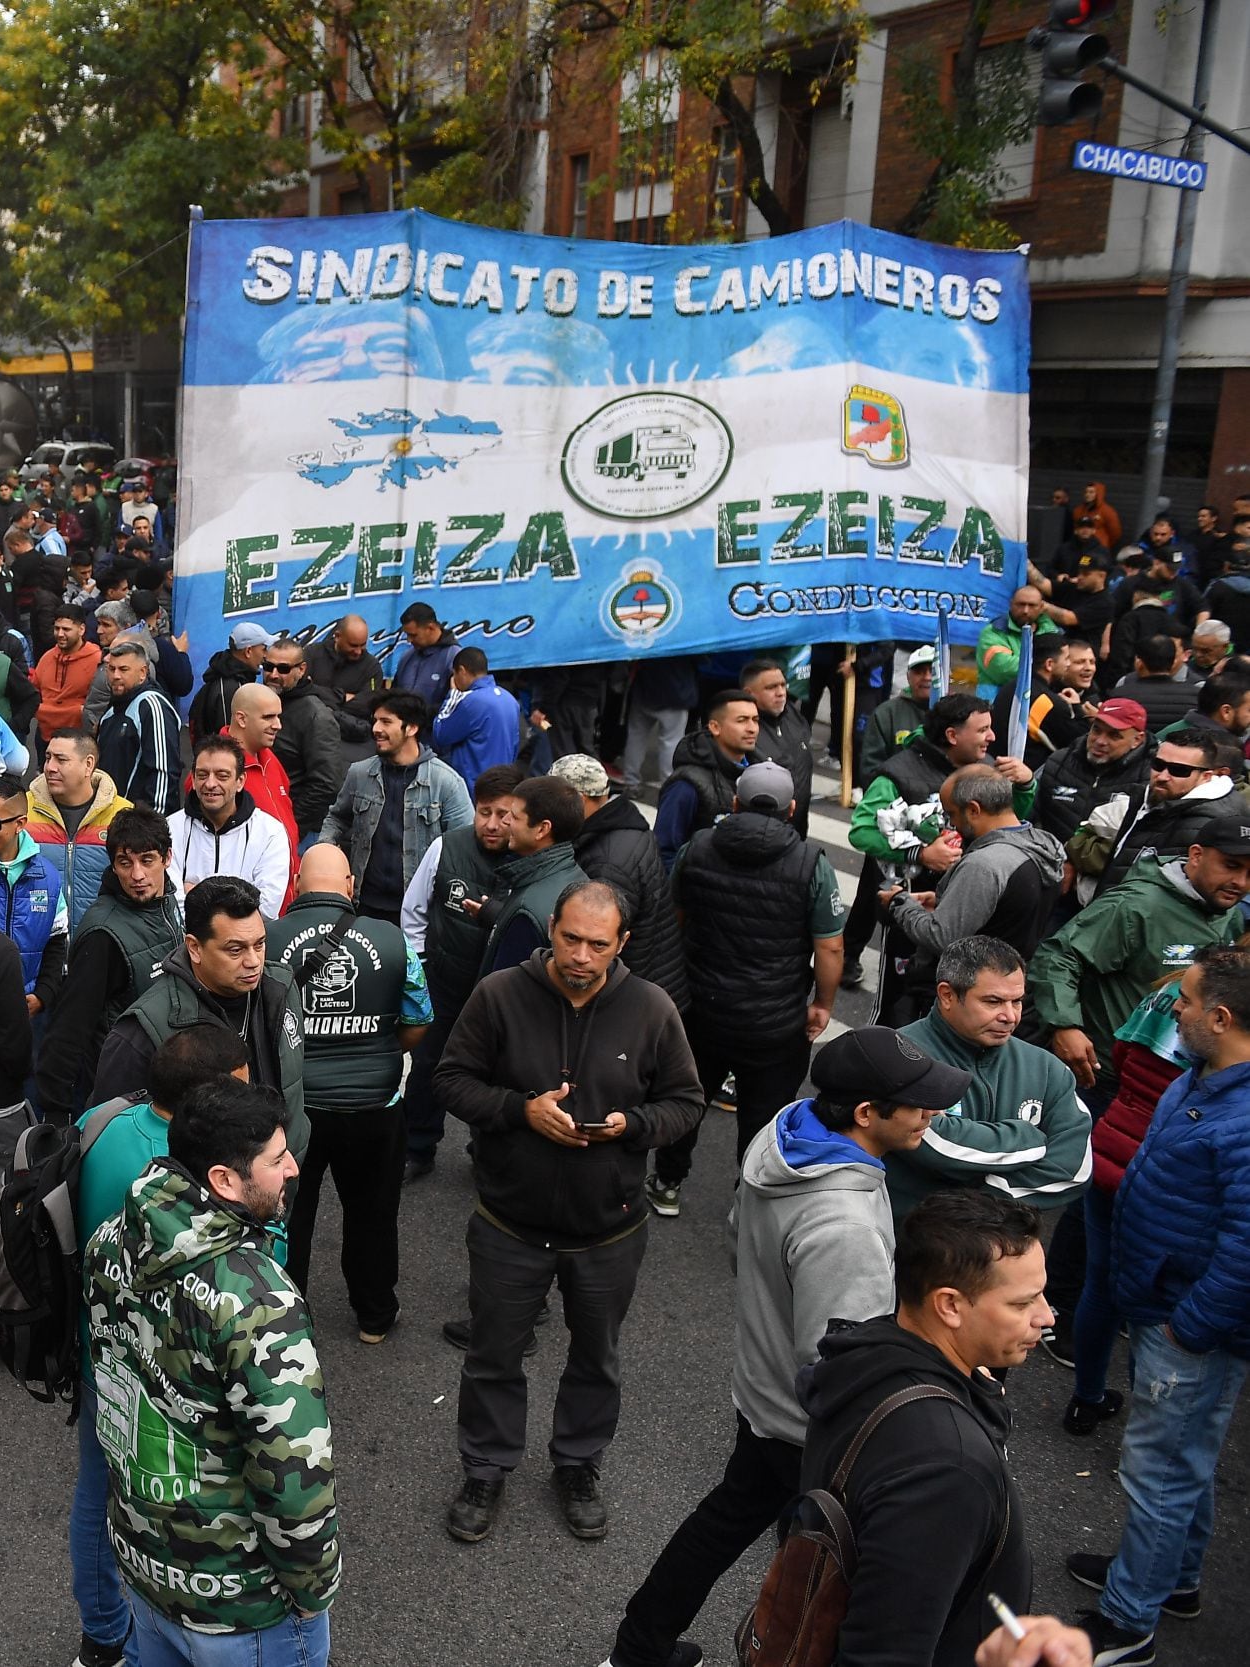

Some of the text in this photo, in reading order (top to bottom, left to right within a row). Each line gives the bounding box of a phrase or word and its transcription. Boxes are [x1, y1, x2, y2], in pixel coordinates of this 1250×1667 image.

[1078, 144, 1203, 187] CHACABUCO
[242, 243, 1002, 322] SINDICATO DE CAMIONEROS
[222, 510, 581, 617] EZEIZA
[715, 489, 1006, 577] EZEIZA
[318, 923, 382, 970] COUCCION
